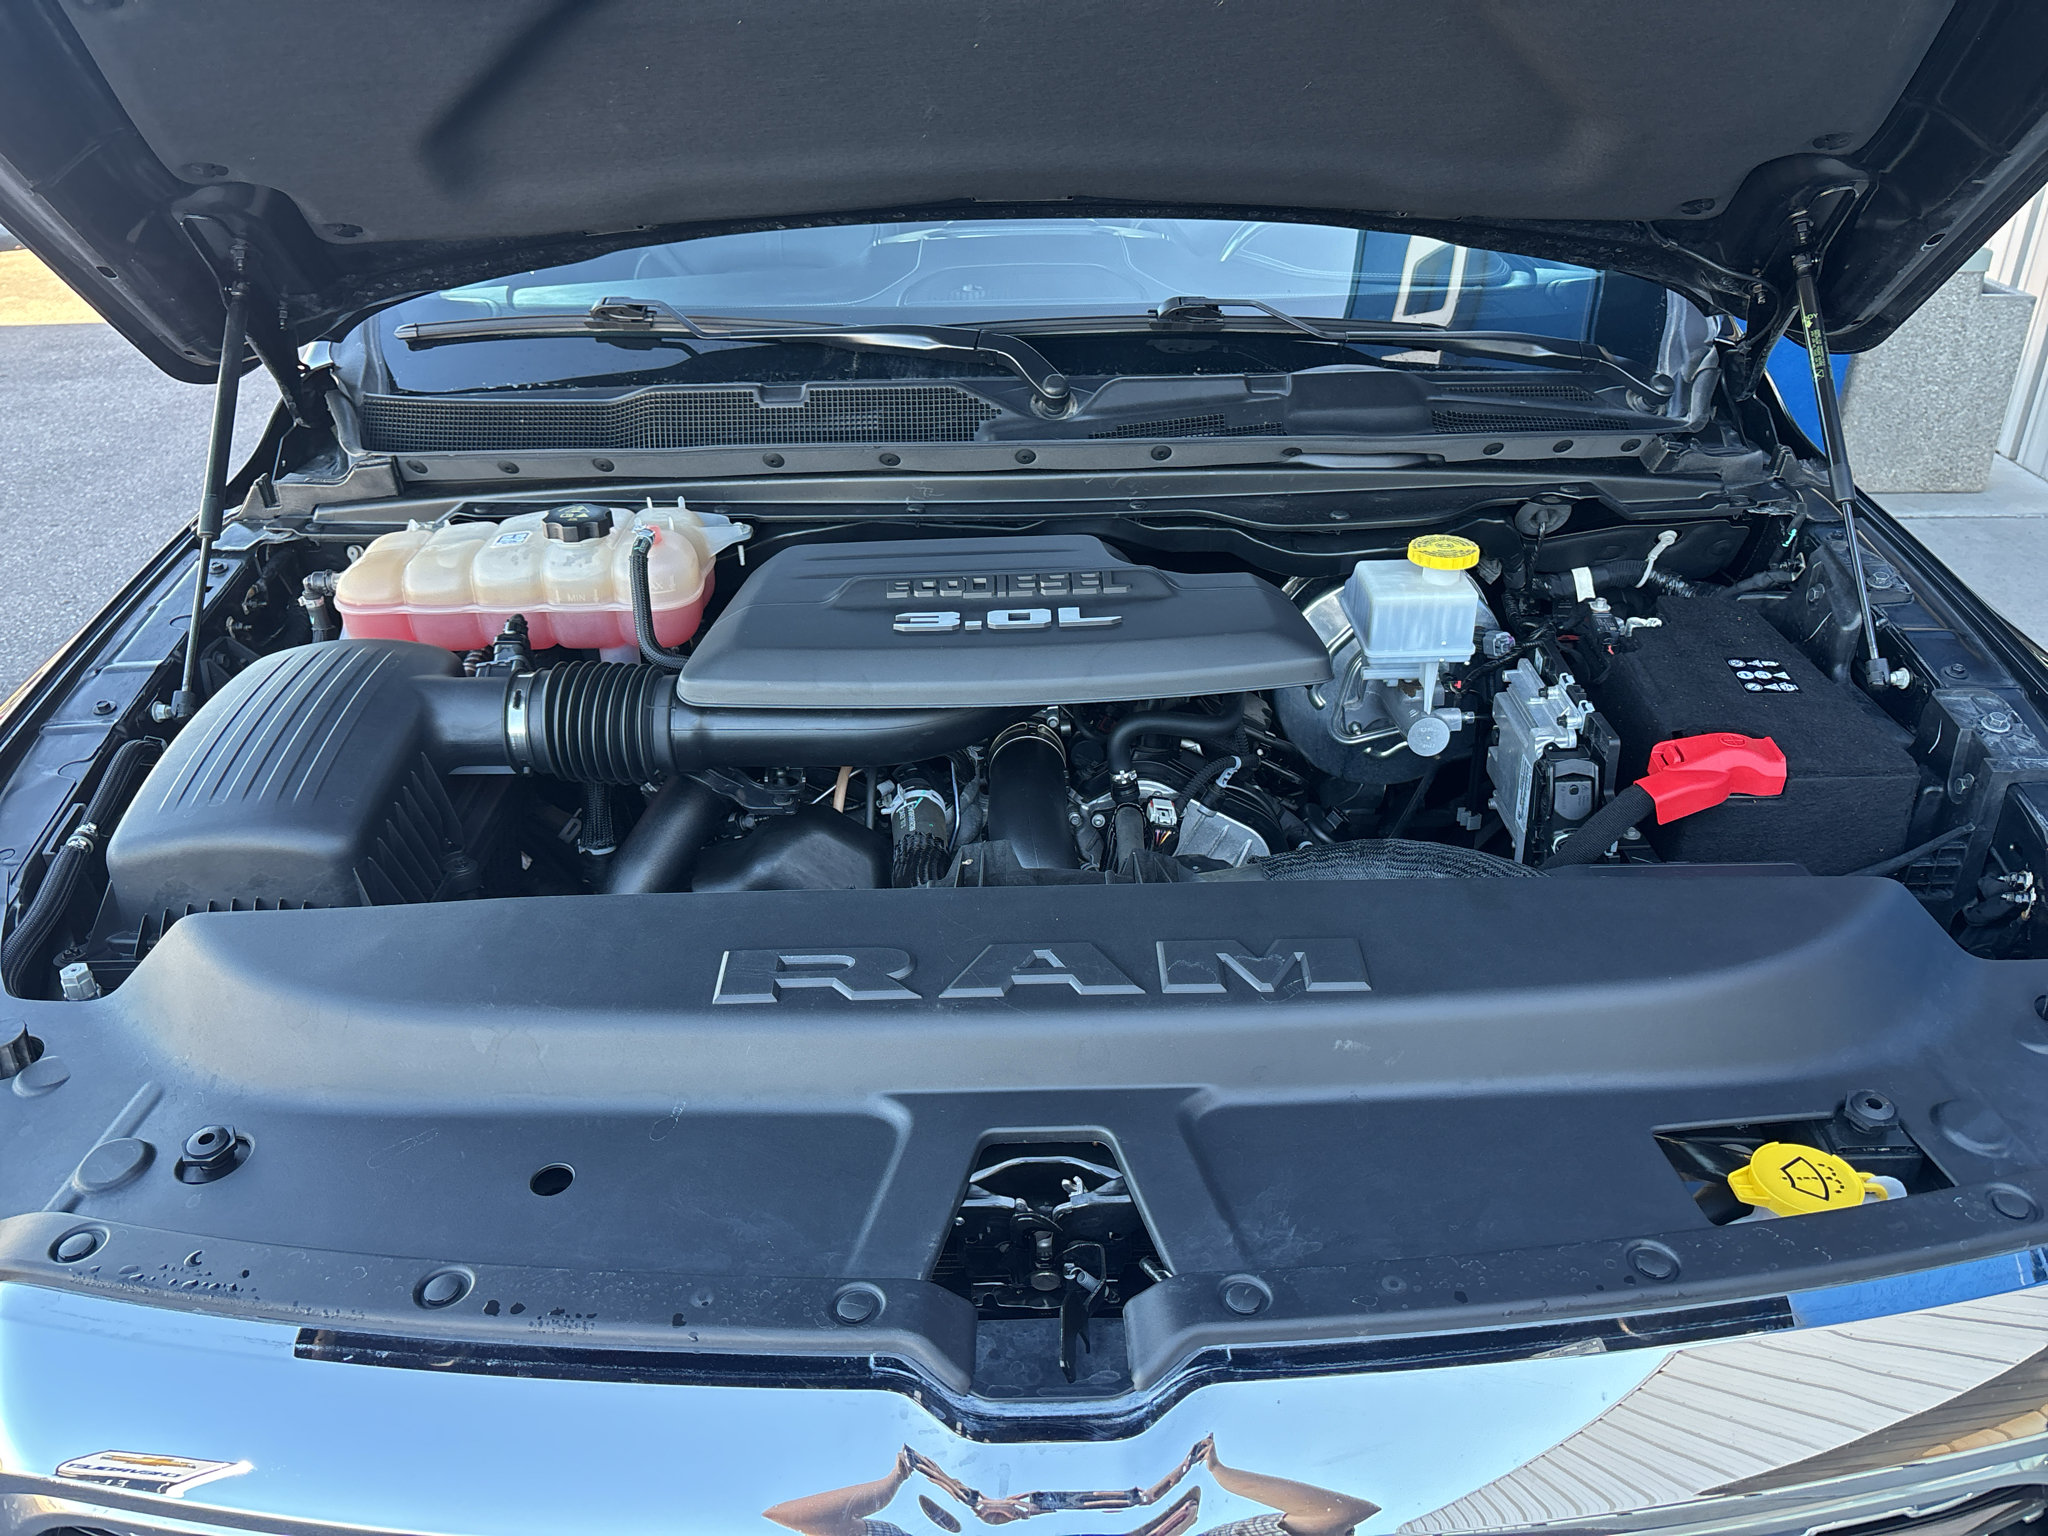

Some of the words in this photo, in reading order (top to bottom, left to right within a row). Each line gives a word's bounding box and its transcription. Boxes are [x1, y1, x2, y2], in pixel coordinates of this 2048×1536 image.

[887, 571, 1131, 598] ECODIESEL
[893, 607, 1122, 632] 3.0L
[712, 938, 1373, 1004] RAM
